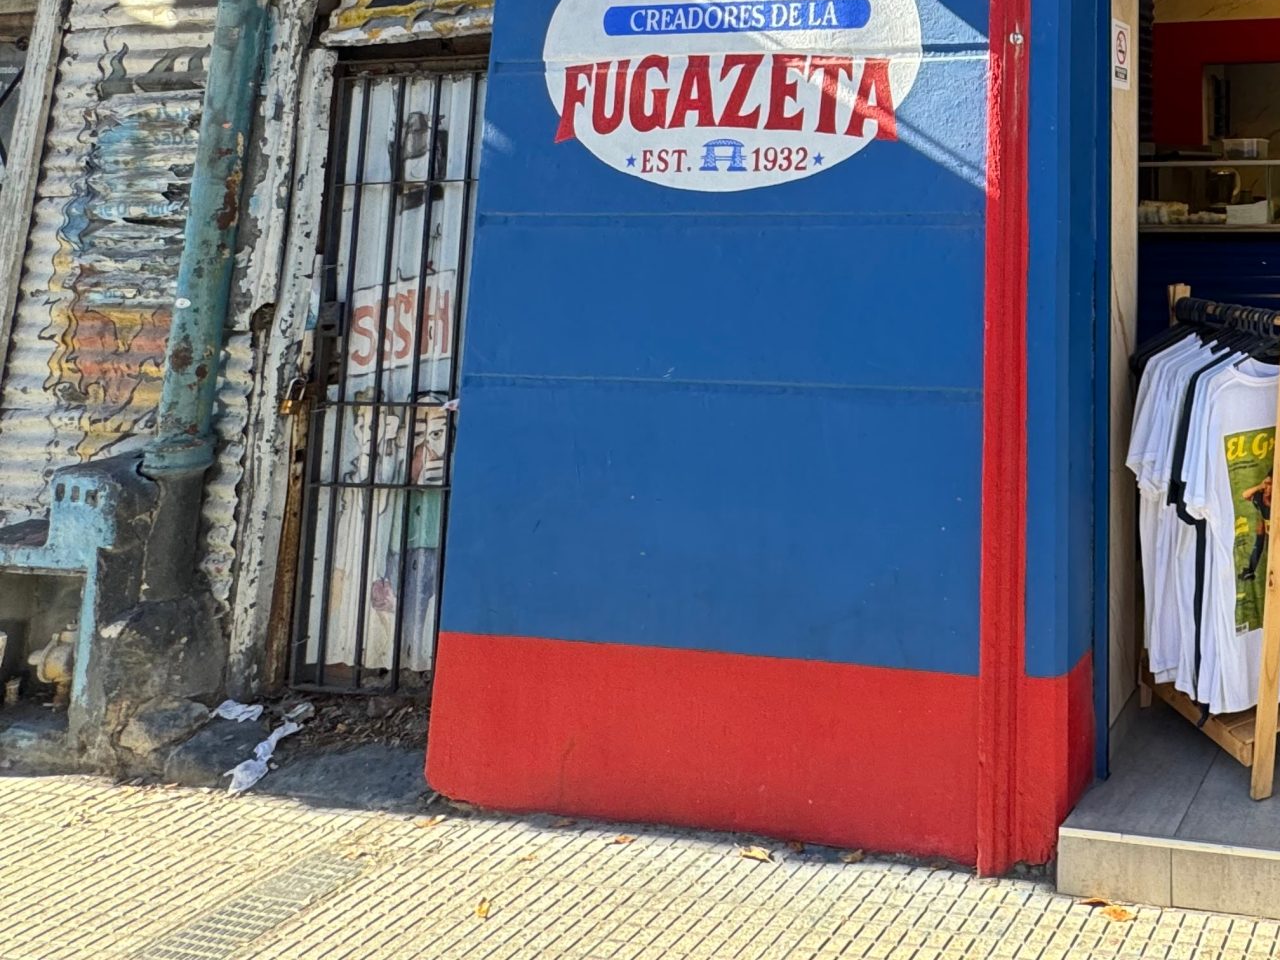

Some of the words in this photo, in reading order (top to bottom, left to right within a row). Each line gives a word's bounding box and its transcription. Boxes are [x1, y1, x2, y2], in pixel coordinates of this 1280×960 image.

[630, 5, 766, 32] CREADORES
[770, 6, 802, 27] DE
[807, 4, 839, 27] LA
[554, 53, 899, 144] FUGAZETA
[640, 149, 692, 174] EST.
[752, 146, 809, 173] 1932
